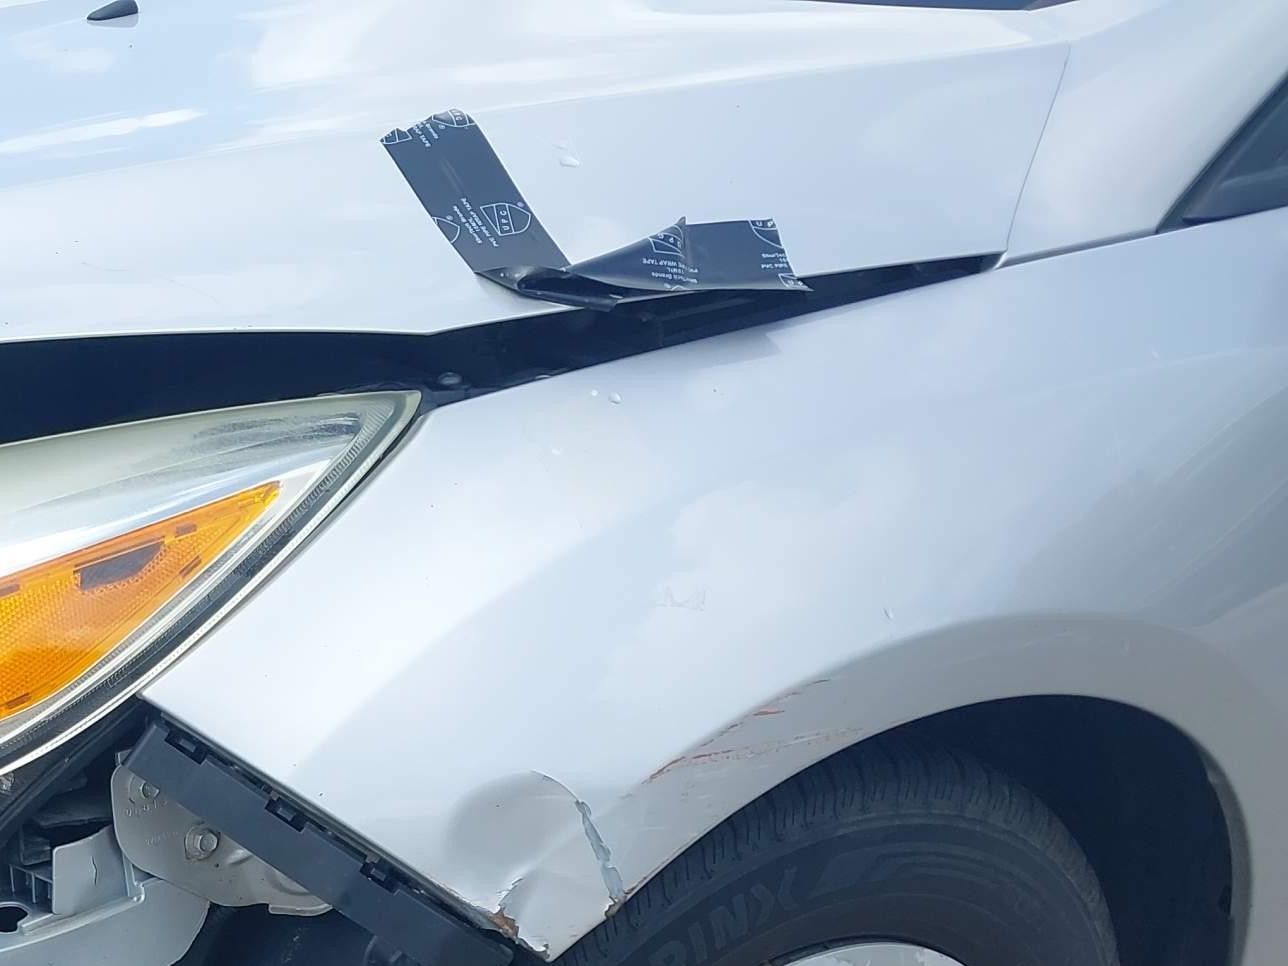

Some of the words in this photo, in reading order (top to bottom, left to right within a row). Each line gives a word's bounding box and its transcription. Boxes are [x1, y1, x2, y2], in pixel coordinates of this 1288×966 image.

[499, 209, 511, 231] UPC
[642, 257, 659, 266] TAPE
[659, 259, 678, 267] WRAP
